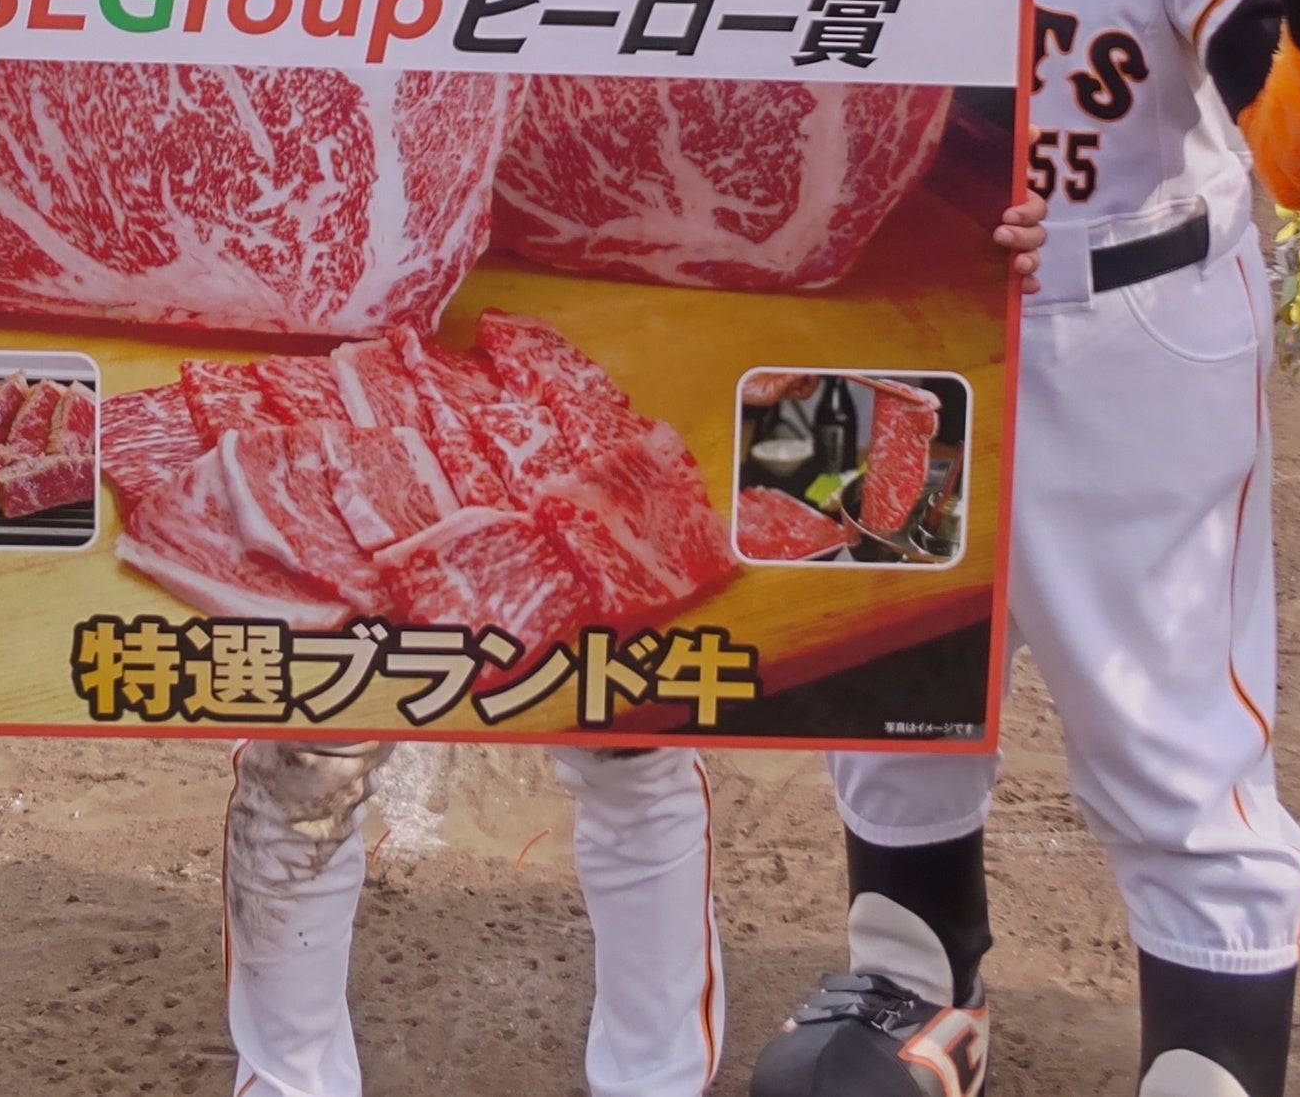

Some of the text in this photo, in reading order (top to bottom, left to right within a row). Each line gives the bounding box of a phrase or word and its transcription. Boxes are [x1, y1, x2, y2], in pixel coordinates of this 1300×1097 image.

[72, 615, 760, 729] 特選ブランド牛
[883, 721, 974, 735] 写真はイメージです
